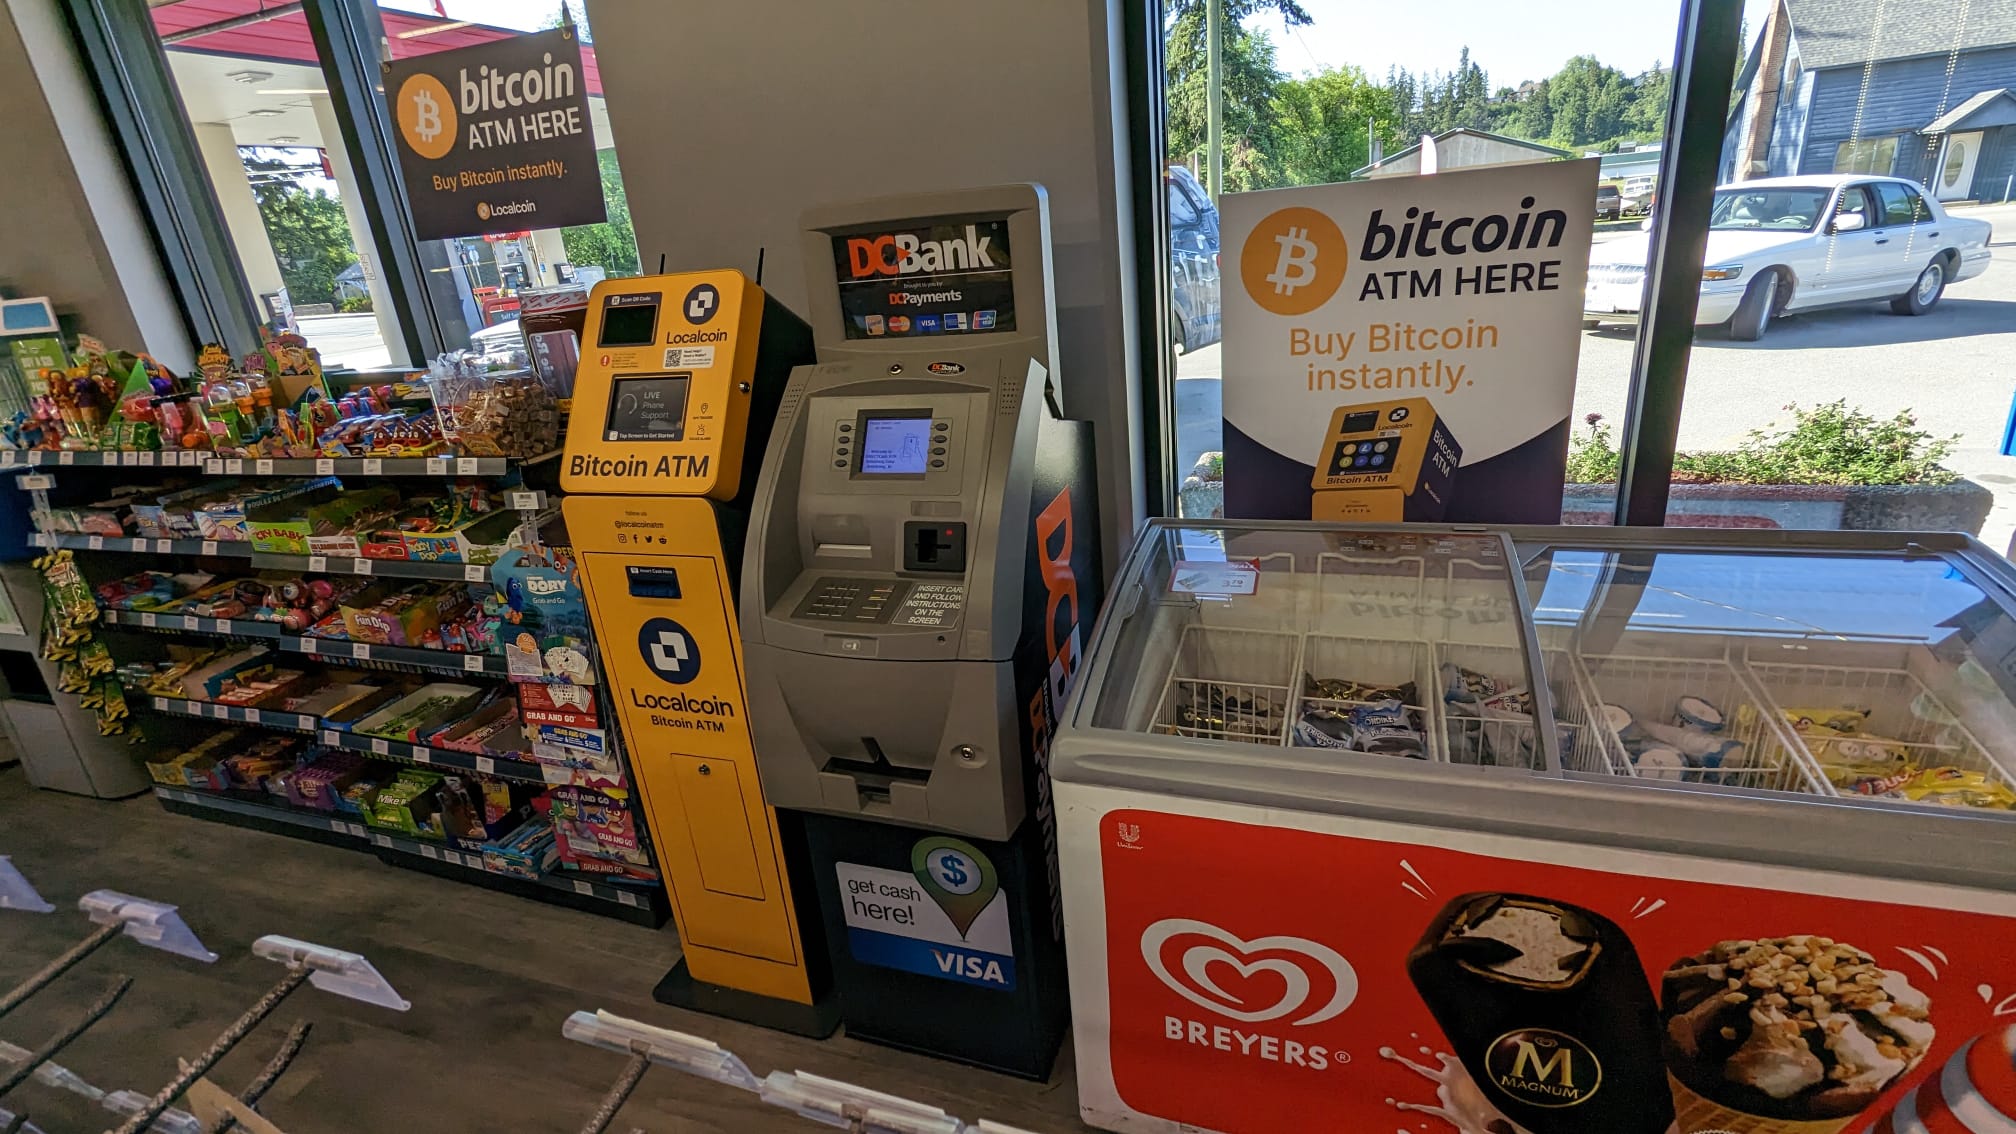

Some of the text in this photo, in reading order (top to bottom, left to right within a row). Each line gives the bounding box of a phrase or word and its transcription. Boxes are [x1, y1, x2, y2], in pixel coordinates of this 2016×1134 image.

[460, 52, 574, 115] bitcoin
[468, 107, 583, 150] ATM HERE
[432, 159, 568, 193] Buy Bitcoin instantly.
[490, 200, 536, 217] Localcoin
[1359, 196, 1567, 261] bitcoin
[1358, 260, 1562, 301] ATM HERE
[889, 290, 962, 307] DCPayments
[666, 329, 727, 344] Localcoin
[1289, 318, 1498, 361] Buy Bitcoin
[1307, 359, 1474, 394] instantly.
[643, 391, 661, 399] LIVE
[1432, 429, 1458, 468] Bitcoin
[570, 454, 710, 478] Bitcoin ATM
[1432, 451, 1450, 478] ATM
[1326, 475, 1389, 485] Bitcoin ATM
[527, 580, 566, 591] DORY
[354, 614, 391, 634] Fun Dip
[630, 687, 734, 717] Localcoin
[526, 712, 546, 720] GRAB
[548, 713, 563, 722] AND
[650, 715, 725, 732] Bitcoin ATM
[377, 794, 399, 805] Mike
[557, 791, 578, 800] GRAB
[580, 794, 596, 803] AND
[598, 832, 613, 841] GRAB
[583, 863, 599, 871] GRAB
[847, 879, 921, 902] get cash
[851, 896, 916, 926] here!
[930, 949, 1006, 985] VISA
[1165, 1015, 1328, 1071] BREYERS
[1501, 1075, 1579, 1099] MAGNUM
